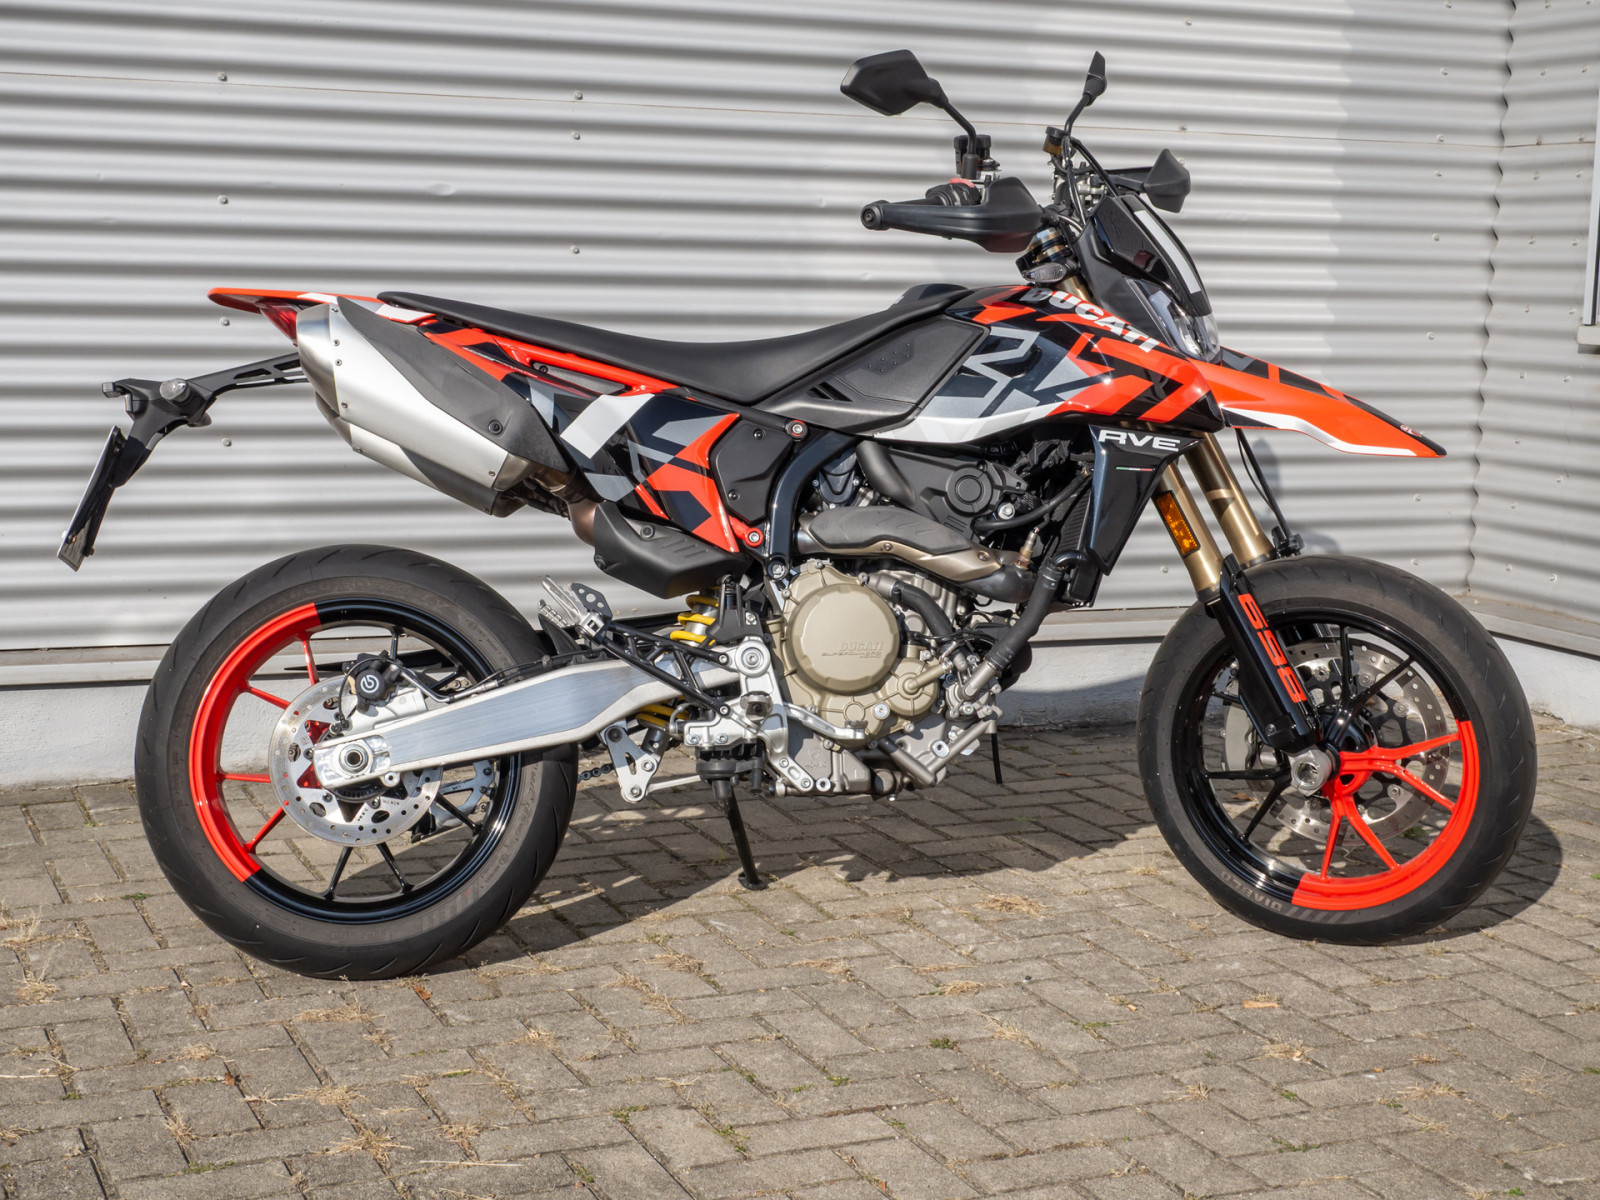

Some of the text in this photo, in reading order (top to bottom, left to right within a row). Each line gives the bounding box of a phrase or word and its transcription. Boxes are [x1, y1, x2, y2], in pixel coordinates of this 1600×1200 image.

[1019, 287, 1160, 353] DUCATI
[1098, 429, 1181, 452] RVE
[839, 640, 884, 652] DUCATI
[1237, 593, 1307, 703] 698
[1220, 871, 1283, 912] DIABLO
